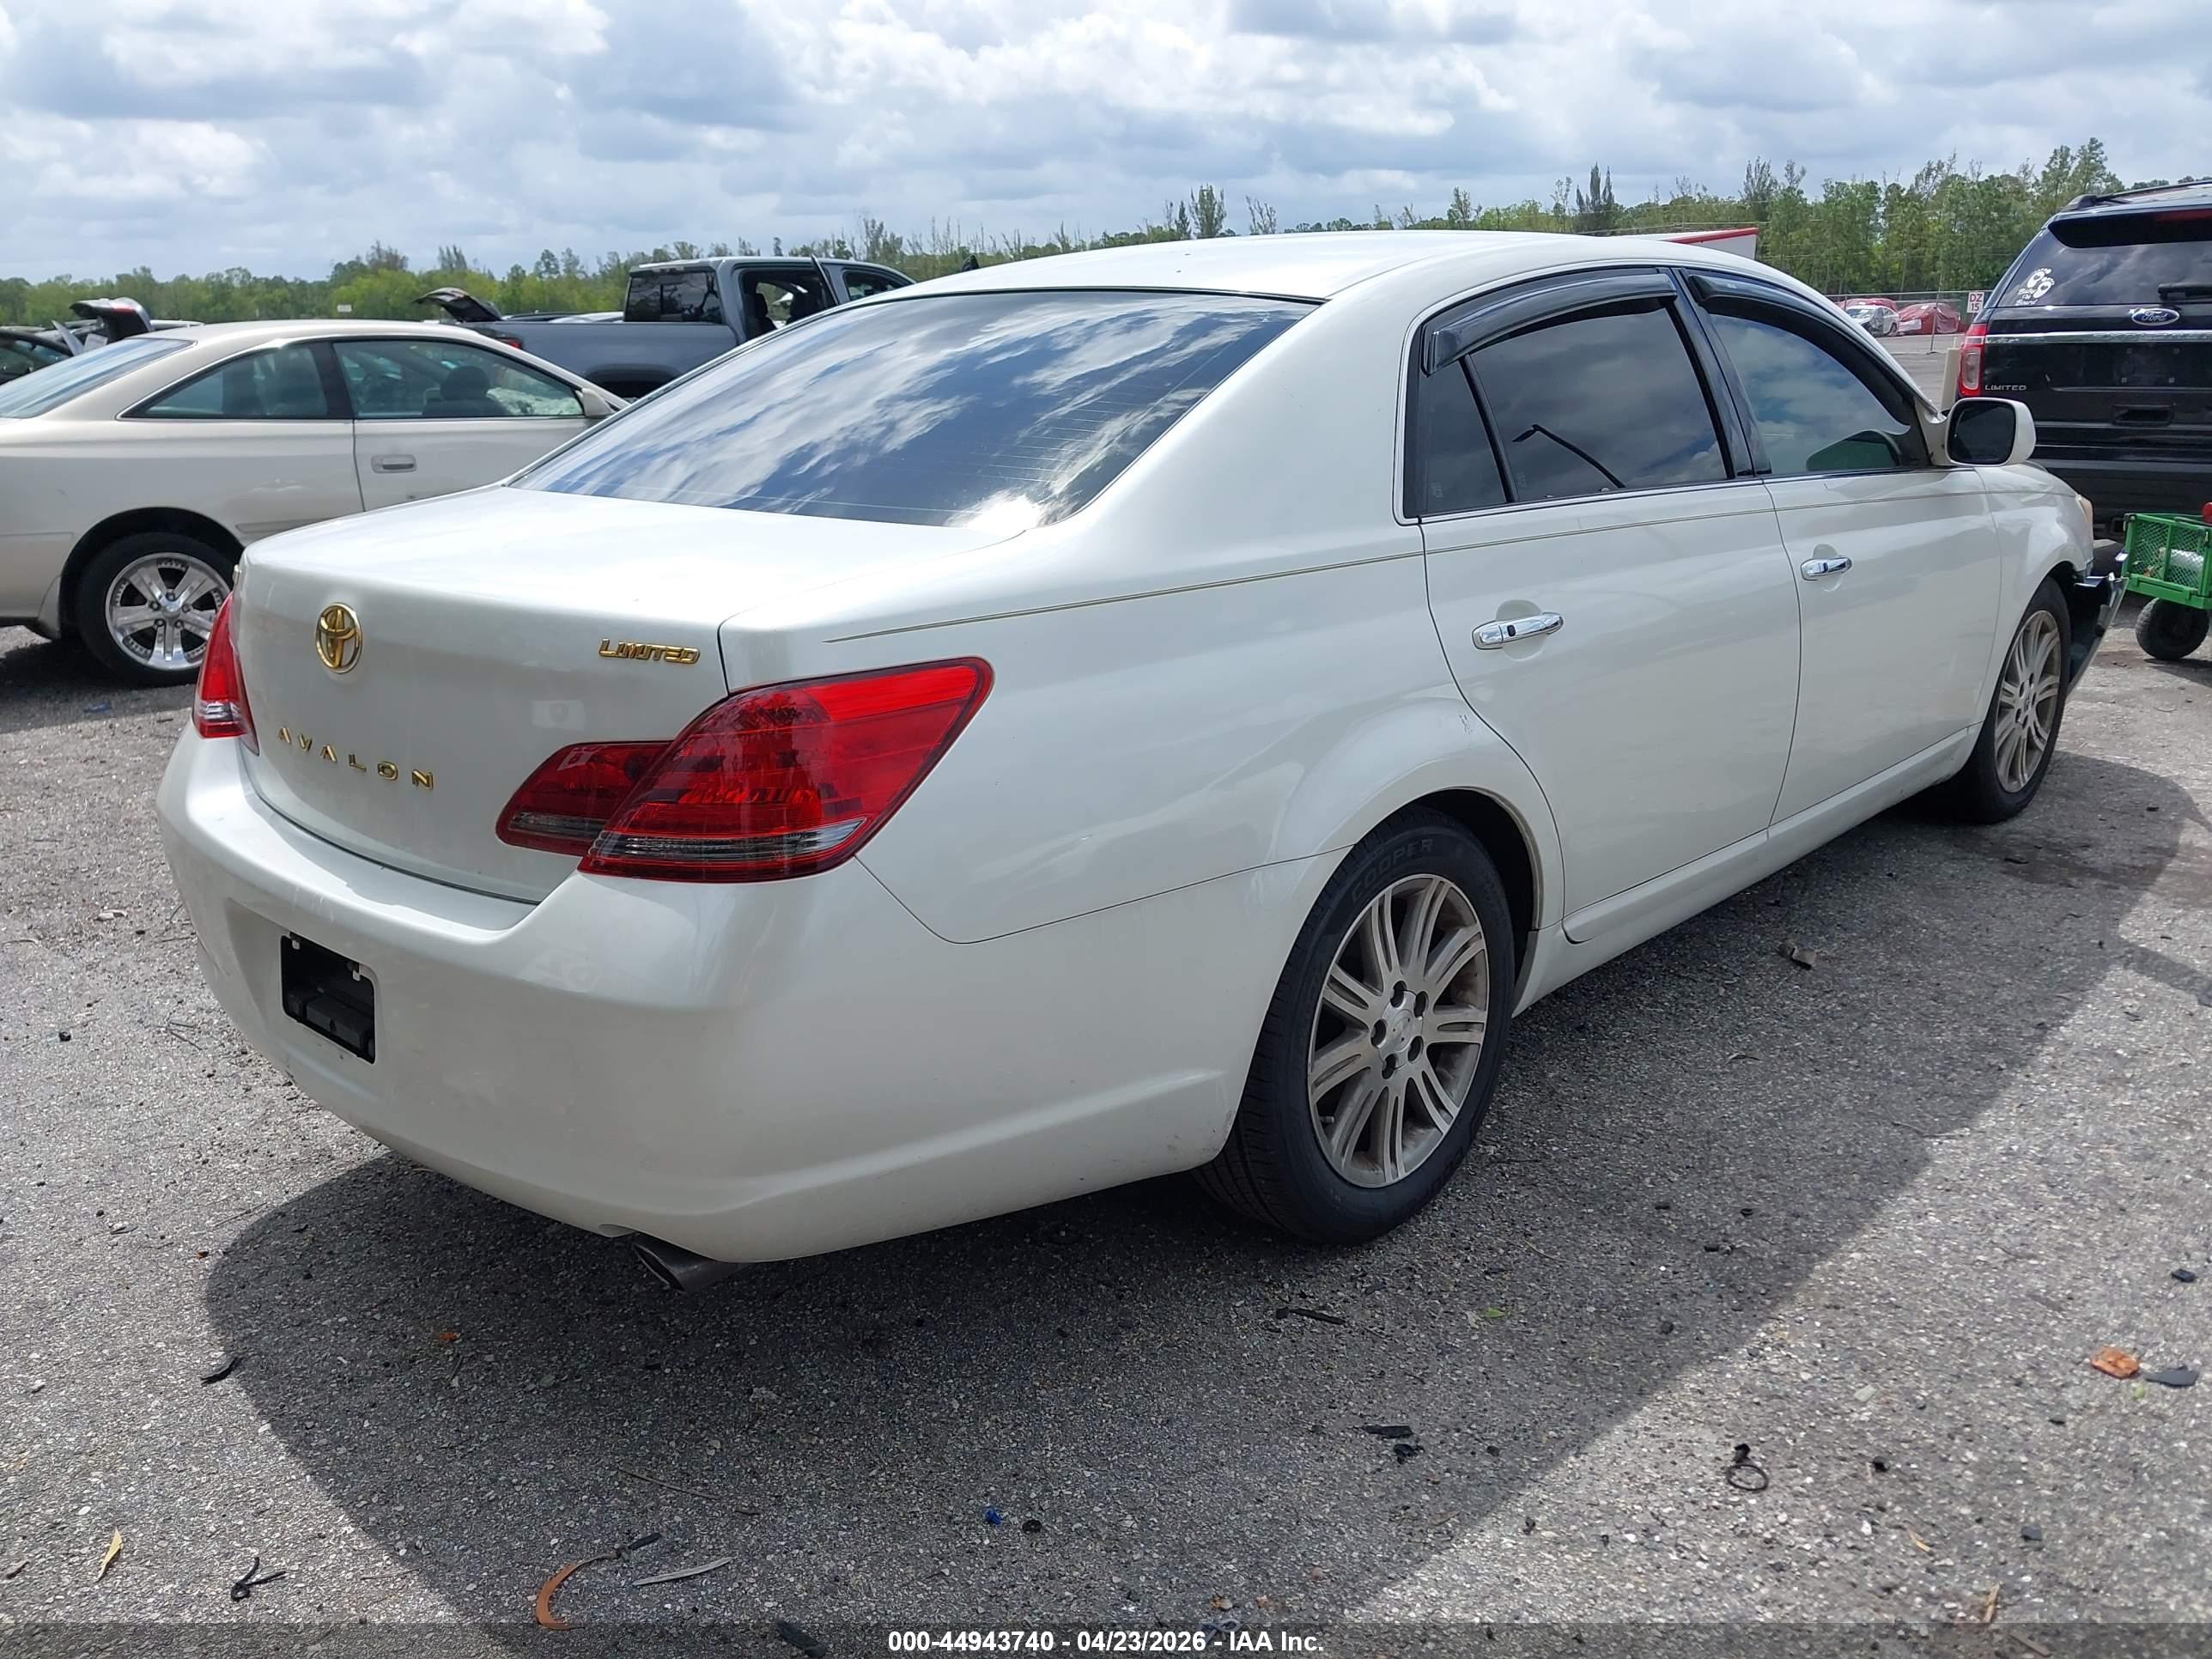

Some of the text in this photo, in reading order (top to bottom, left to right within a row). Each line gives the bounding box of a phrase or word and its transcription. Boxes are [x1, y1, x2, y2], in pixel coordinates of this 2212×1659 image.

[1970, 294, 1983, 302] DZ
[2142, 312, 2168, 321] Ford
[599, 638, 701, 664] LIMITED
[277, 726, 434, 790] AVALON
[1352, 838, 1433, 903] COOPER
